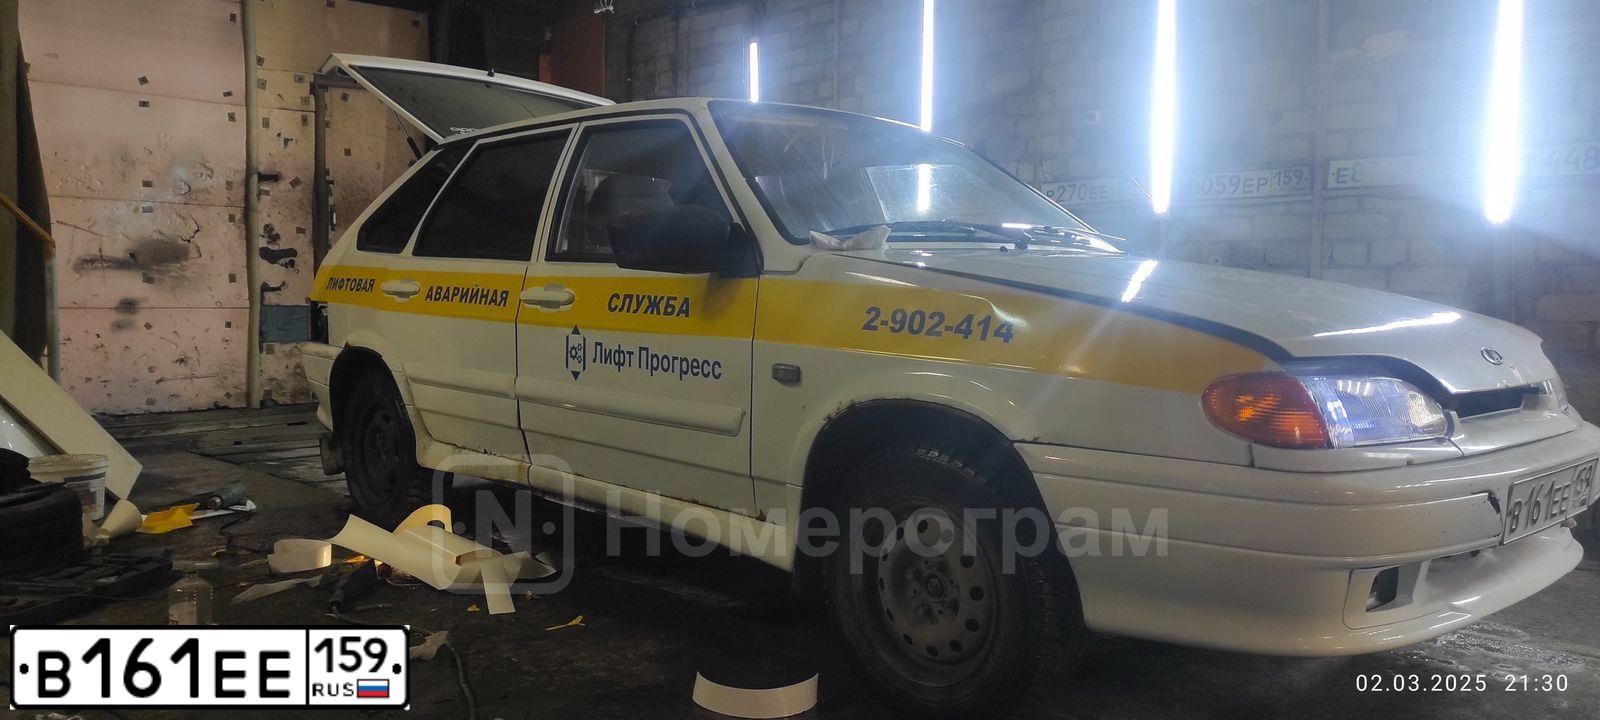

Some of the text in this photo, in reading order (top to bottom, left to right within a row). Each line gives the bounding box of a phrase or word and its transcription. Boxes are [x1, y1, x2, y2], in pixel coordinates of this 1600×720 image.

[326, 276, 691, 318] ЛИФТОВАЯ АВАРИЙНАЯ СЛУЖБА
[862, 306, 1014, 344] 2-902-414
[592, 341, 722, 381] Лифт Прогресс
[1509, 480, 1571, 534] В161ЕЕ
